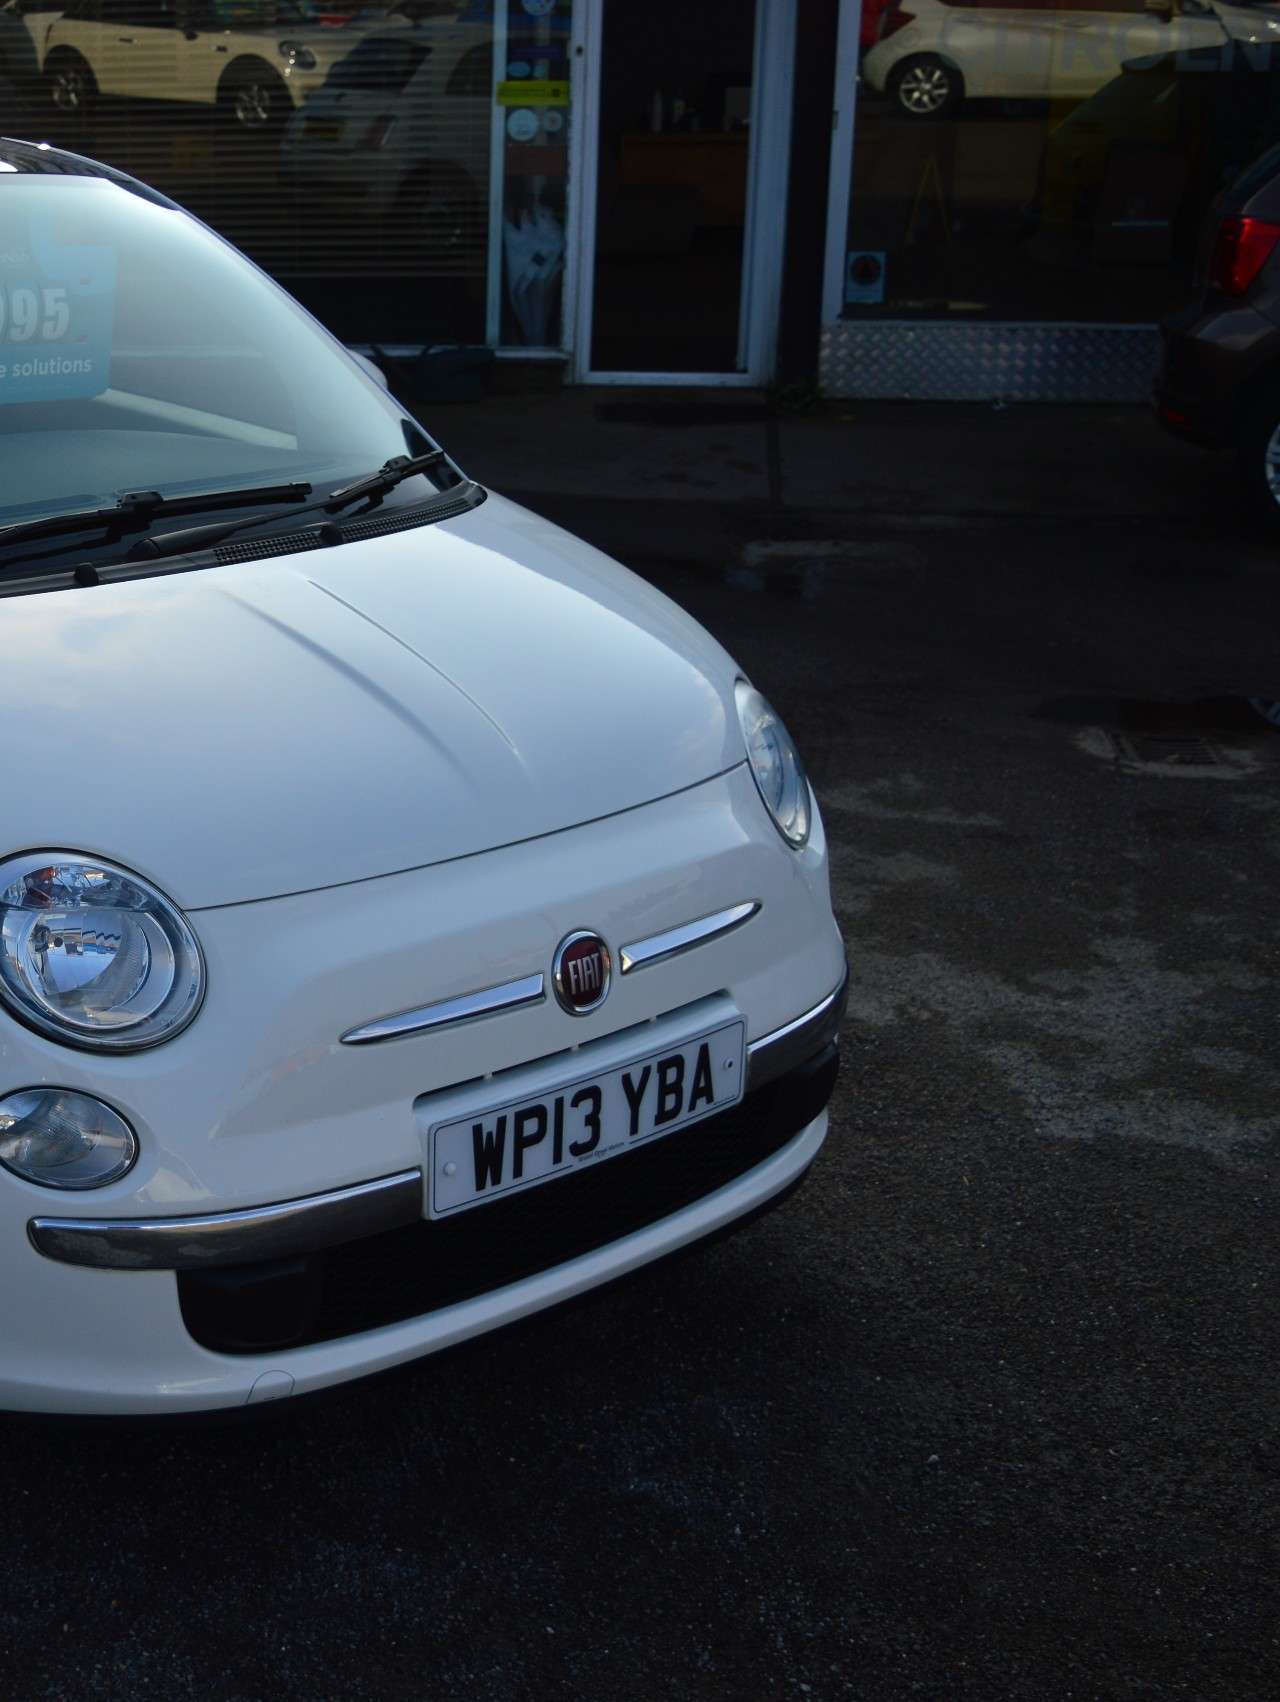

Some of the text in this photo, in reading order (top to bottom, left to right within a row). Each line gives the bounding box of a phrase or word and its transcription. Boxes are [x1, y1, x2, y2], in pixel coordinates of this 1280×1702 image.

[12, 356, 93, 378] solutions
[568, 952, 600, 996] FIAT
[471, 1042, 715, 1193] WP13 YBA
